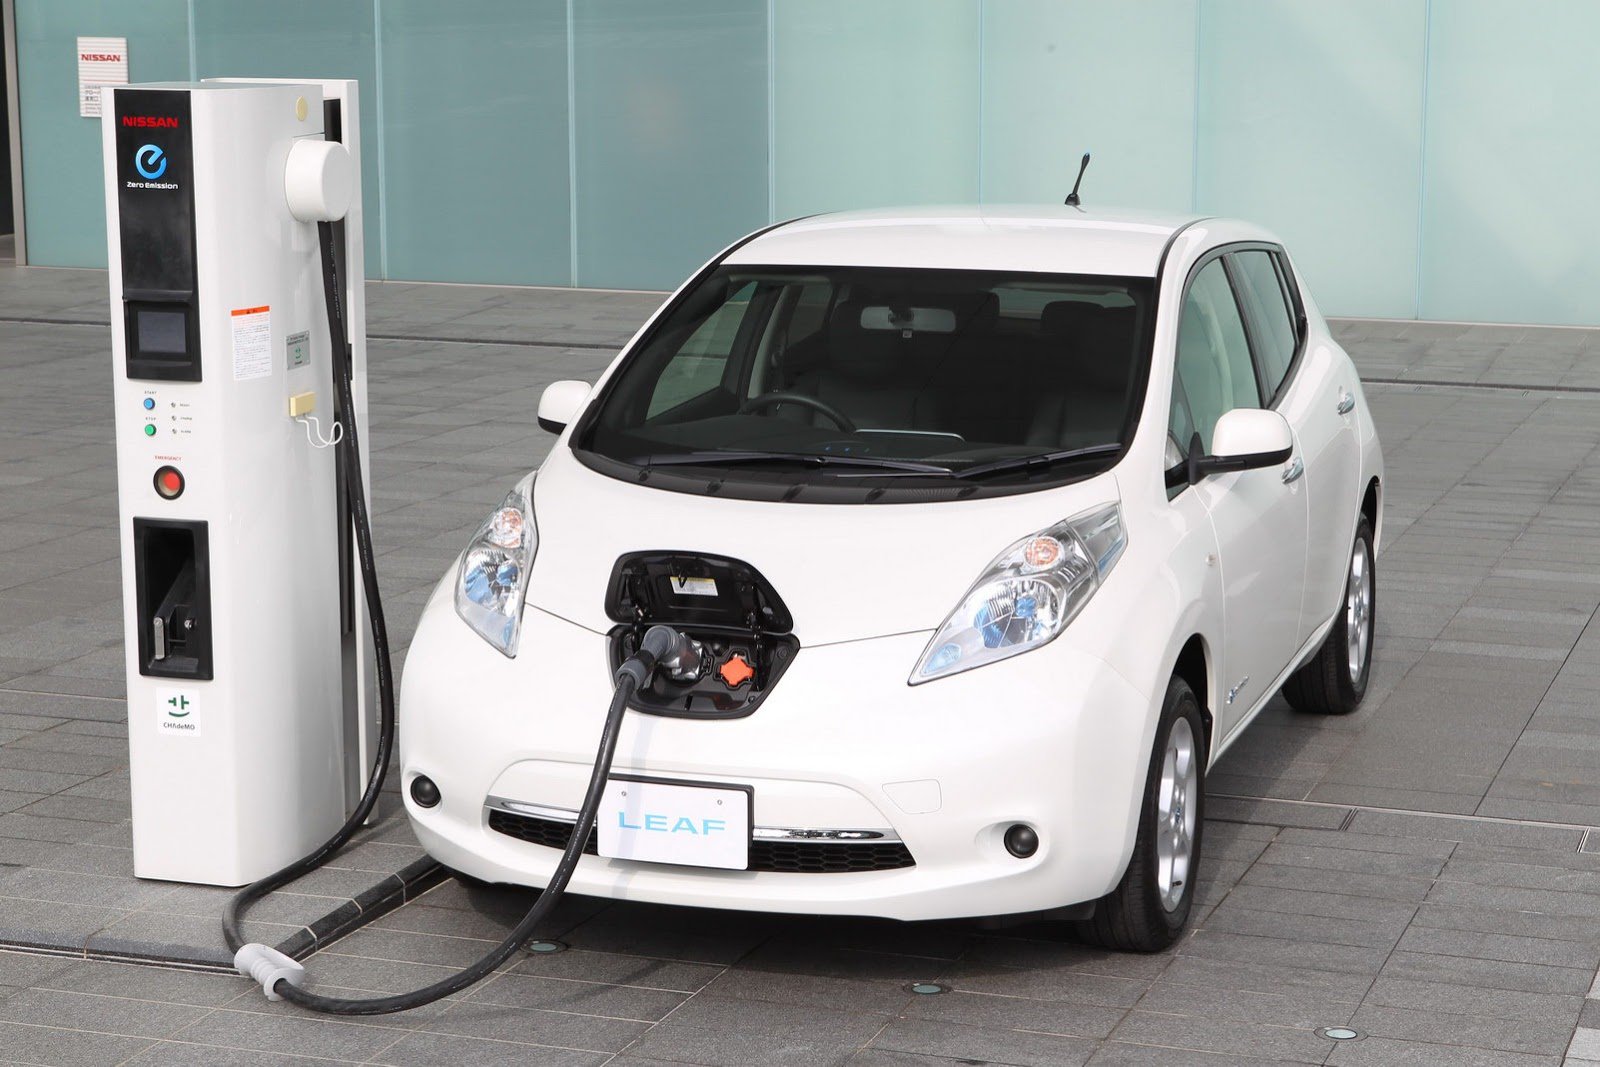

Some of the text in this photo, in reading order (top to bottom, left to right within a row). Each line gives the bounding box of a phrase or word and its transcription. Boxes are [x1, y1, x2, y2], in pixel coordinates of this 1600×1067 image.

[81, 53, 121, 62] NISSAN
[122, 116, 179, 128] NISSAN
[126, 181, 179, 190] Zero Emission
[163, 722, 195, 730] CHAdeMO
[618, 811, 726, 836] LEAF
